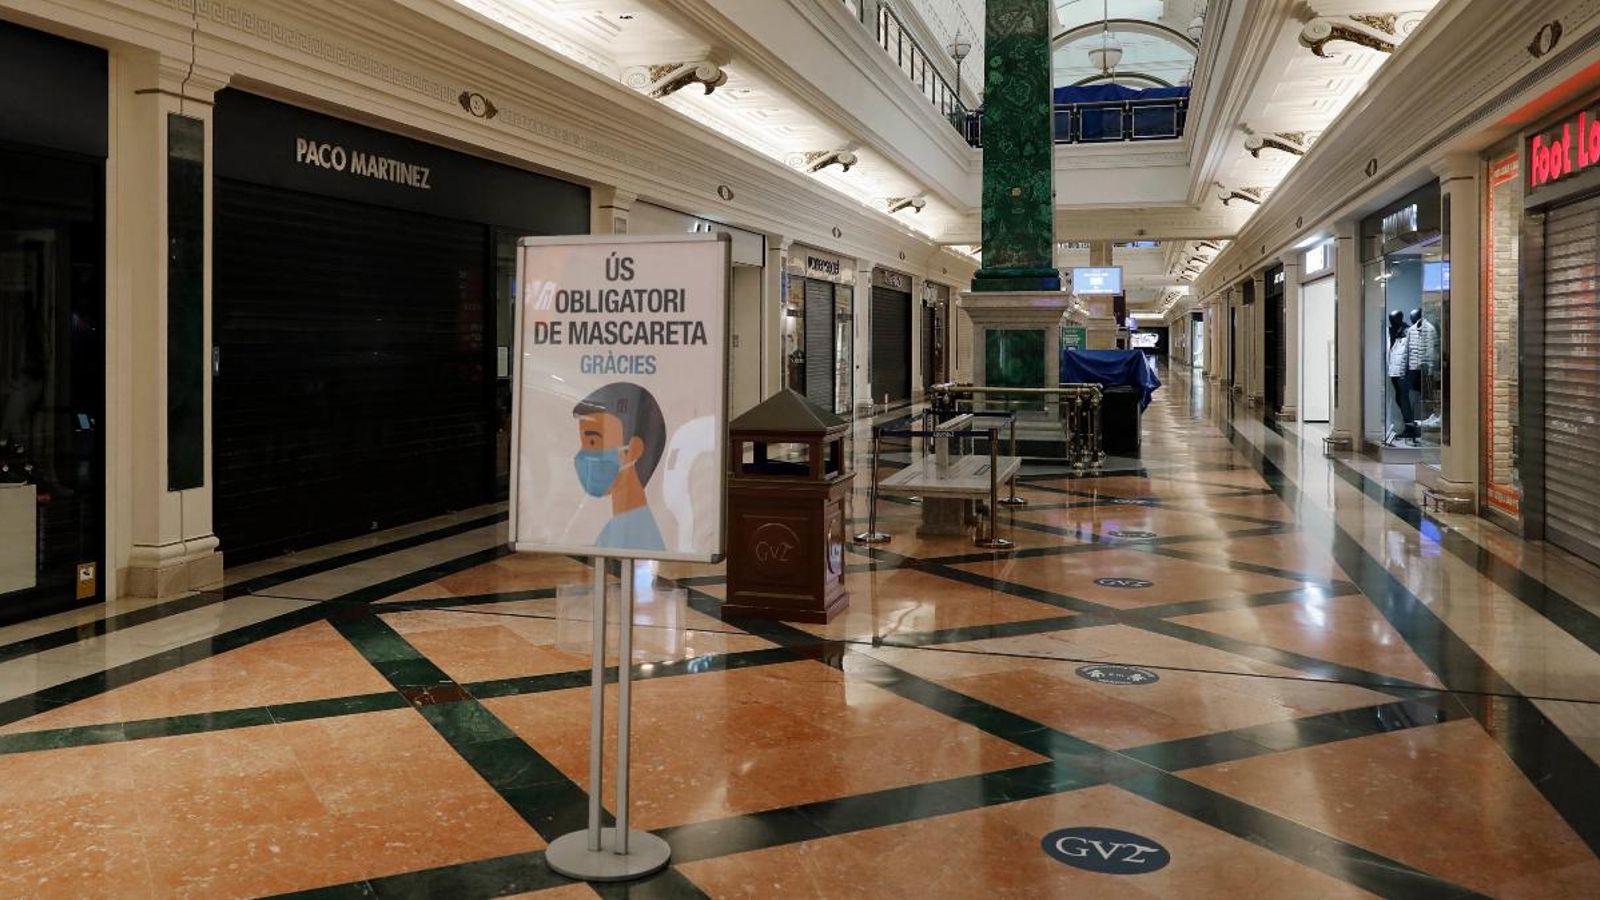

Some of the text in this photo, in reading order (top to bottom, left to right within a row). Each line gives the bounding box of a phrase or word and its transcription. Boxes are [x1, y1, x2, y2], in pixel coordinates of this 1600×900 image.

[296, 138, 431, 188] PACO MARTINEZ
[1532, 134, 1571, 187] Foot
[605, 251, 635, 281] ÚS
[555, 288, 686, 313] OBLIGATORI
[534, 321, 708, 345] DE MASCARETA
[580, 350, 657, 374] GRÀCIES
[1056, 836, 1160, 863] GV2
